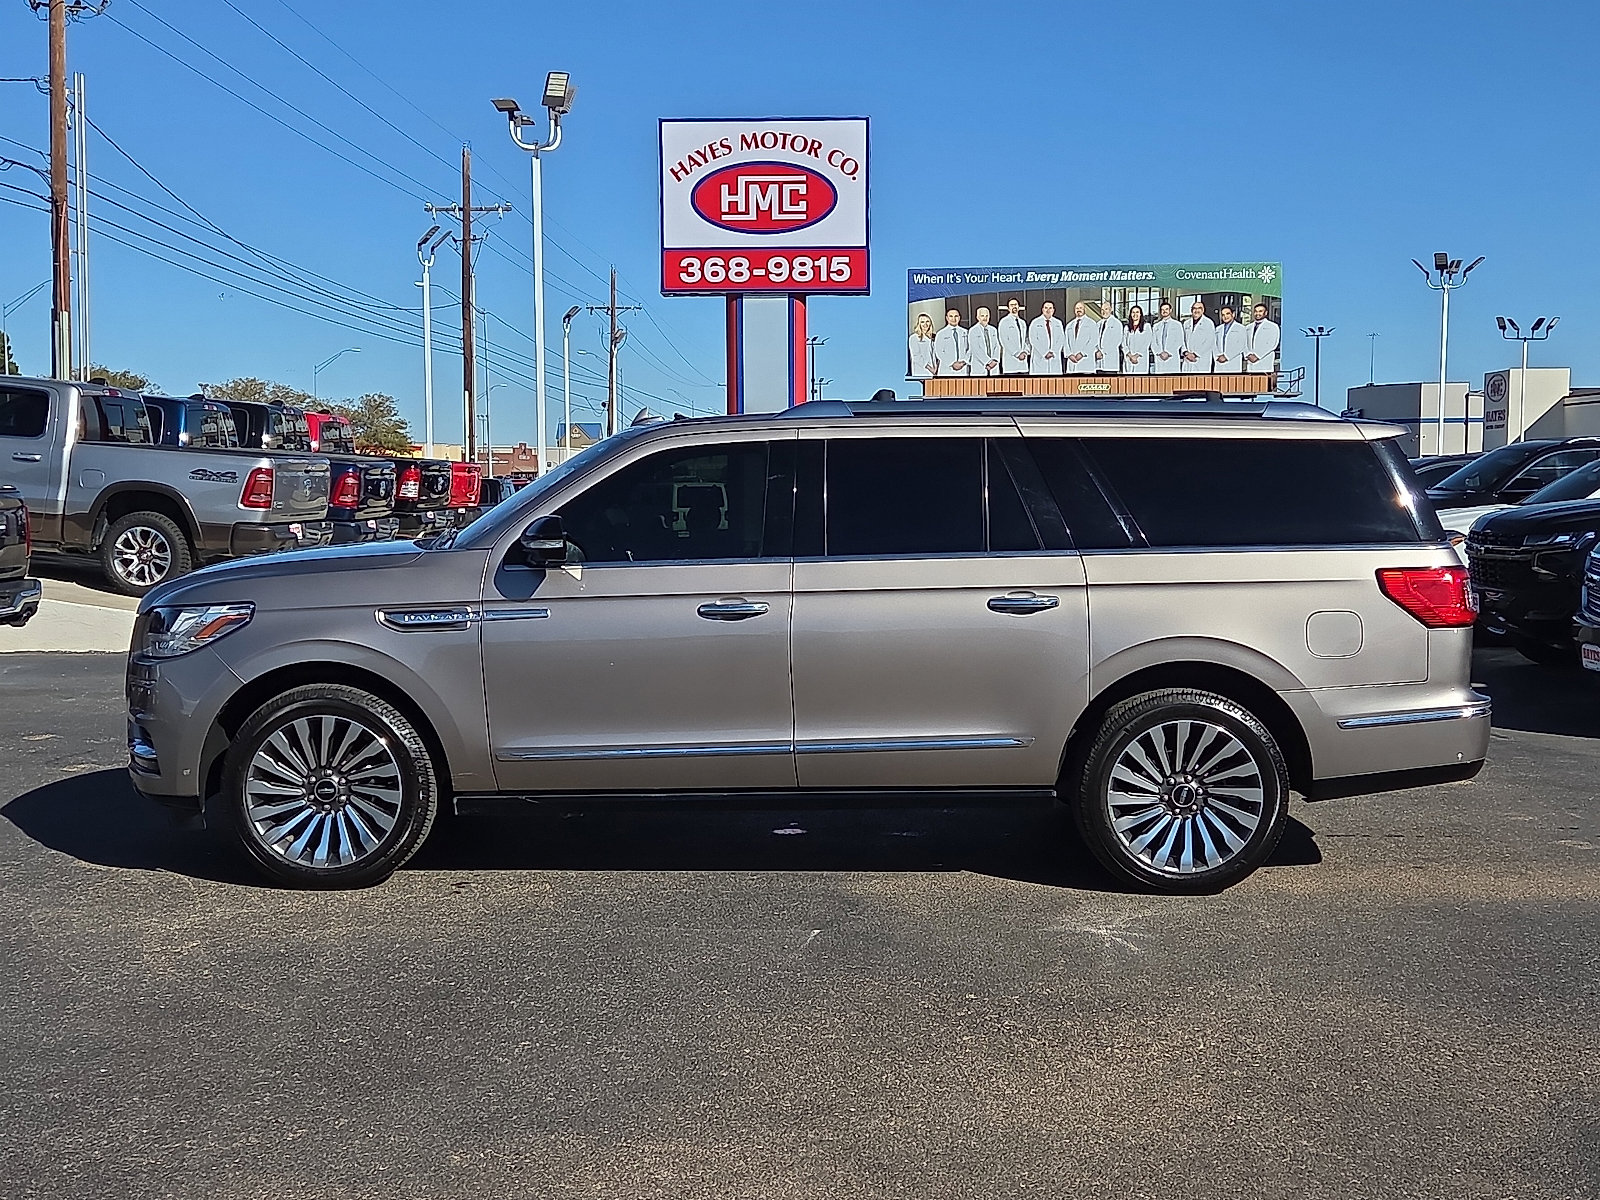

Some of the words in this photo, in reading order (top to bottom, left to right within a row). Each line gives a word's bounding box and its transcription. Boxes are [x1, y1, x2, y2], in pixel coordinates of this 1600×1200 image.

[669, 138, 733, 182] HAYES
[740, 131, 823, 159] MOTOR
[827, 149, 859, 181] CO.
[720, 174, 807, 221] HMC
[679, 256, 851, 283] 368-9815
[913, 273, 944, 284] When
[946, 272, 961, 283] It's
[964, 272, 988, 283] Your
[991, 271, 1024, 284] Heart,
[1025, 271, 1060, 284] Every
[1060, 270, 1108, 283] Moment
[1109, 270, 1156, 281] Matters.
